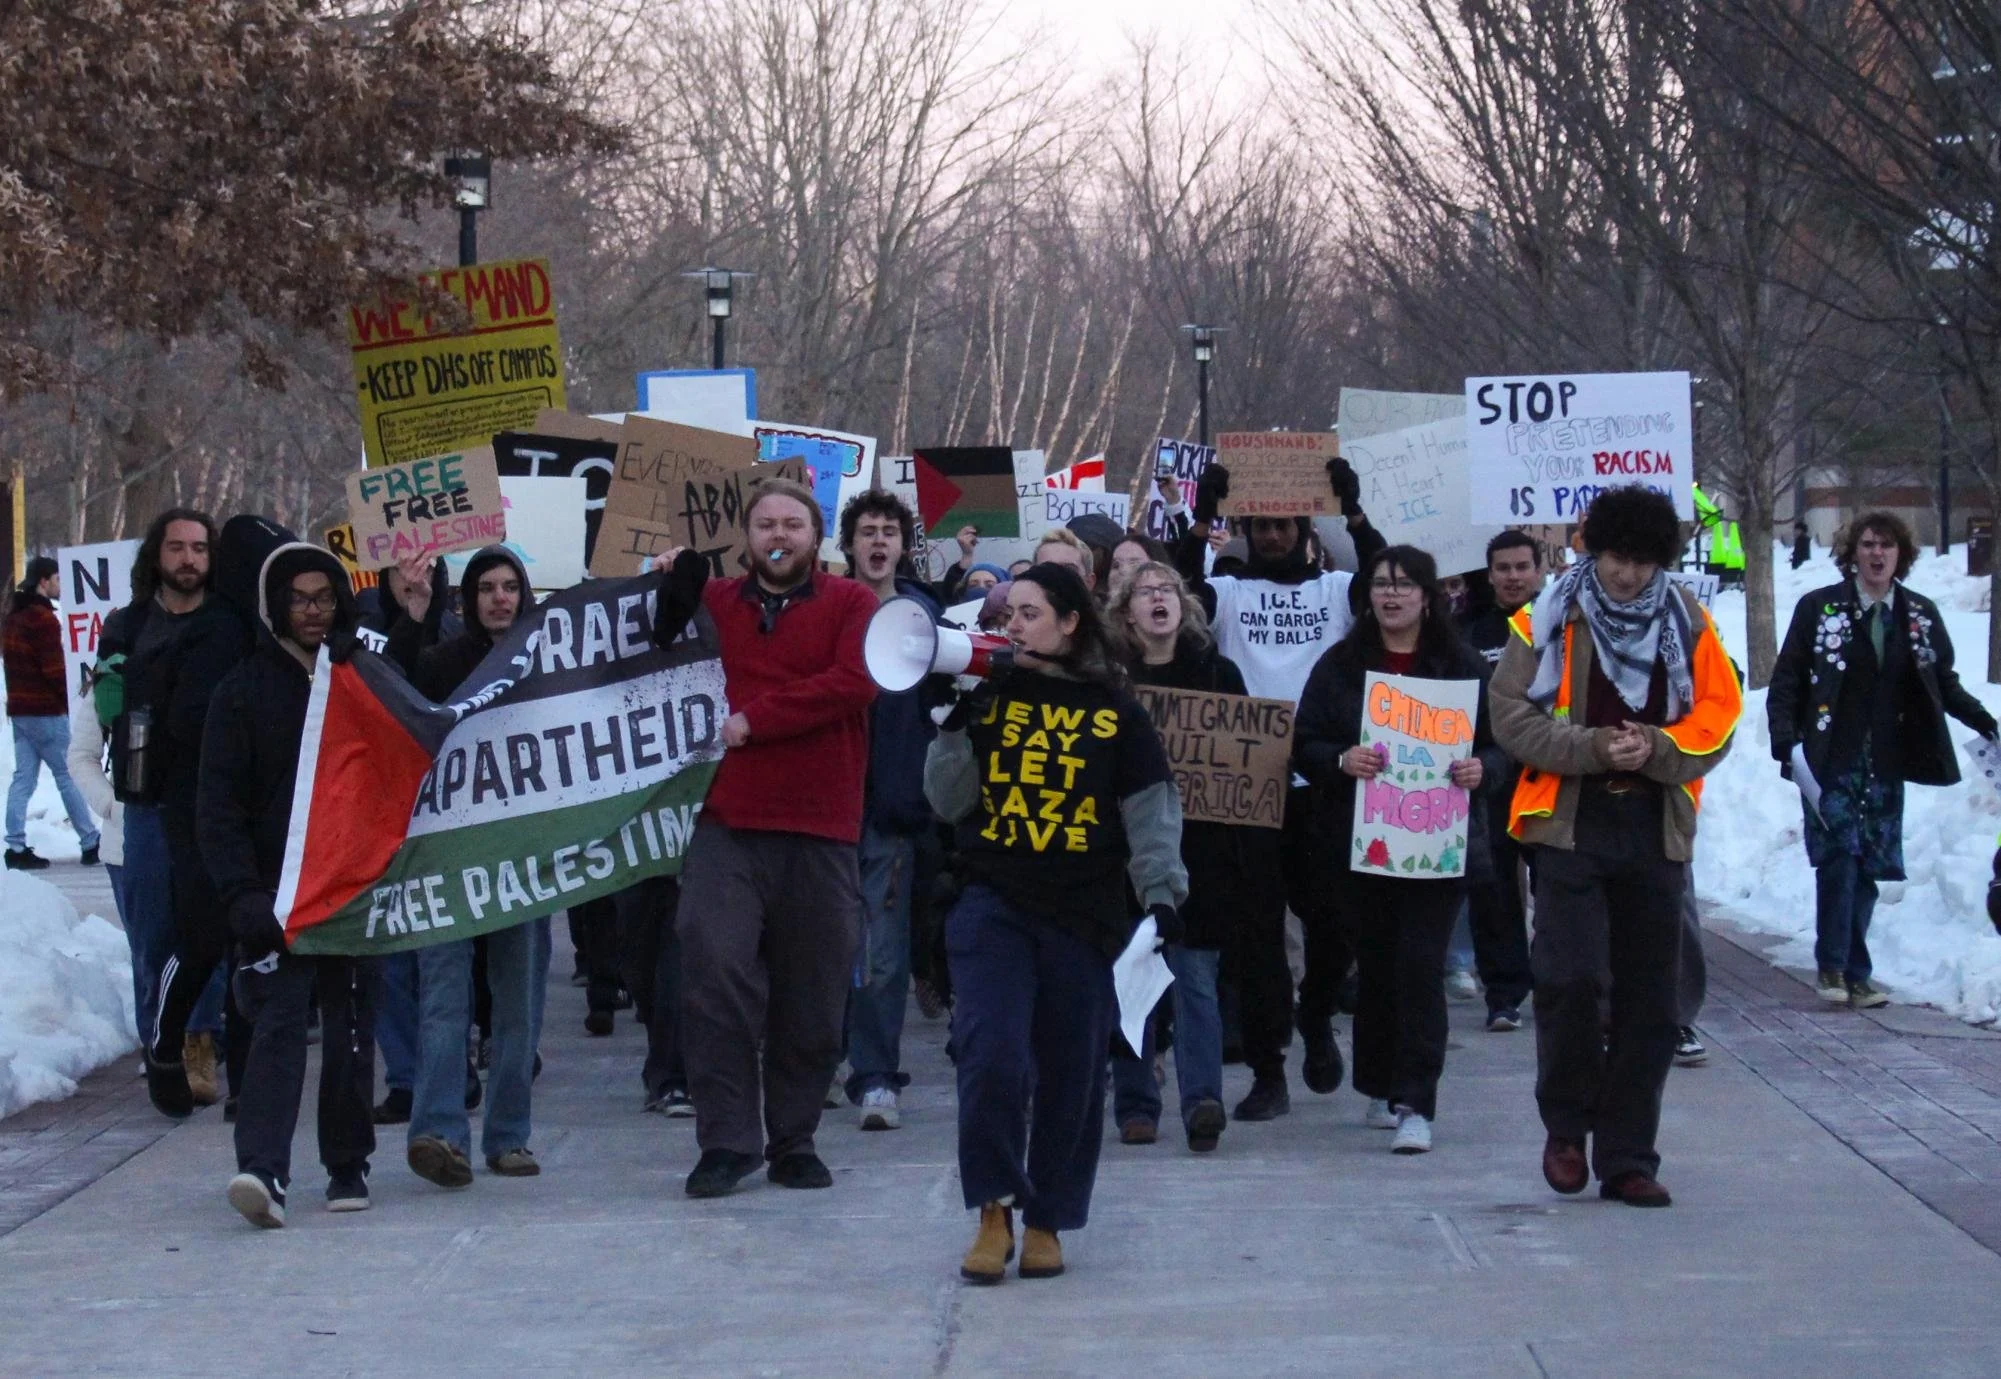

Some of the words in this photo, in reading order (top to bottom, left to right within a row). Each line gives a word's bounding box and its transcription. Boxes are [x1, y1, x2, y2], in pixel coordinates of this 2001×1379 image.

[366, 360, 418, 404] KEEP
[422, 350, 469, 396] DHS
[470, 349, 495, 386] OFF
[499, 344, 558, 384] CAMPUS
[1477, 381, 1577, 425] STOP
[1505, 411, 1675, 456] PRETENDING
[359, 454, 467, 503] FREE
[1523, 454, 1584, 484] YOUR
[1592, 450, 1673, 475] RACISM
[382, 486, 474, 529] FREE
[1510, 486, 1535, 517] IS
[366, 512, 506, 562] PALESTINE
[1240, 611, 1269, 627] CAN
[1274, 607, 1329, 628] GARGLE
[1248, 629, 1269, 645] MY
[1275, 626, 1323, 645] BALLS
[981, 696, 1119, 739] JEWS
[1368, 681, 1473, 745] CHINGA
[413, 693, 717, 818] APARTHEID
[1002, 723, 1081, 753] SAY
[1397, 744, 1435, 767] LA
[988, 750, 1085, 790] LET
[1363, 778, 1470, 835] MIGRA
[365, 874, 454, 938] FREE
